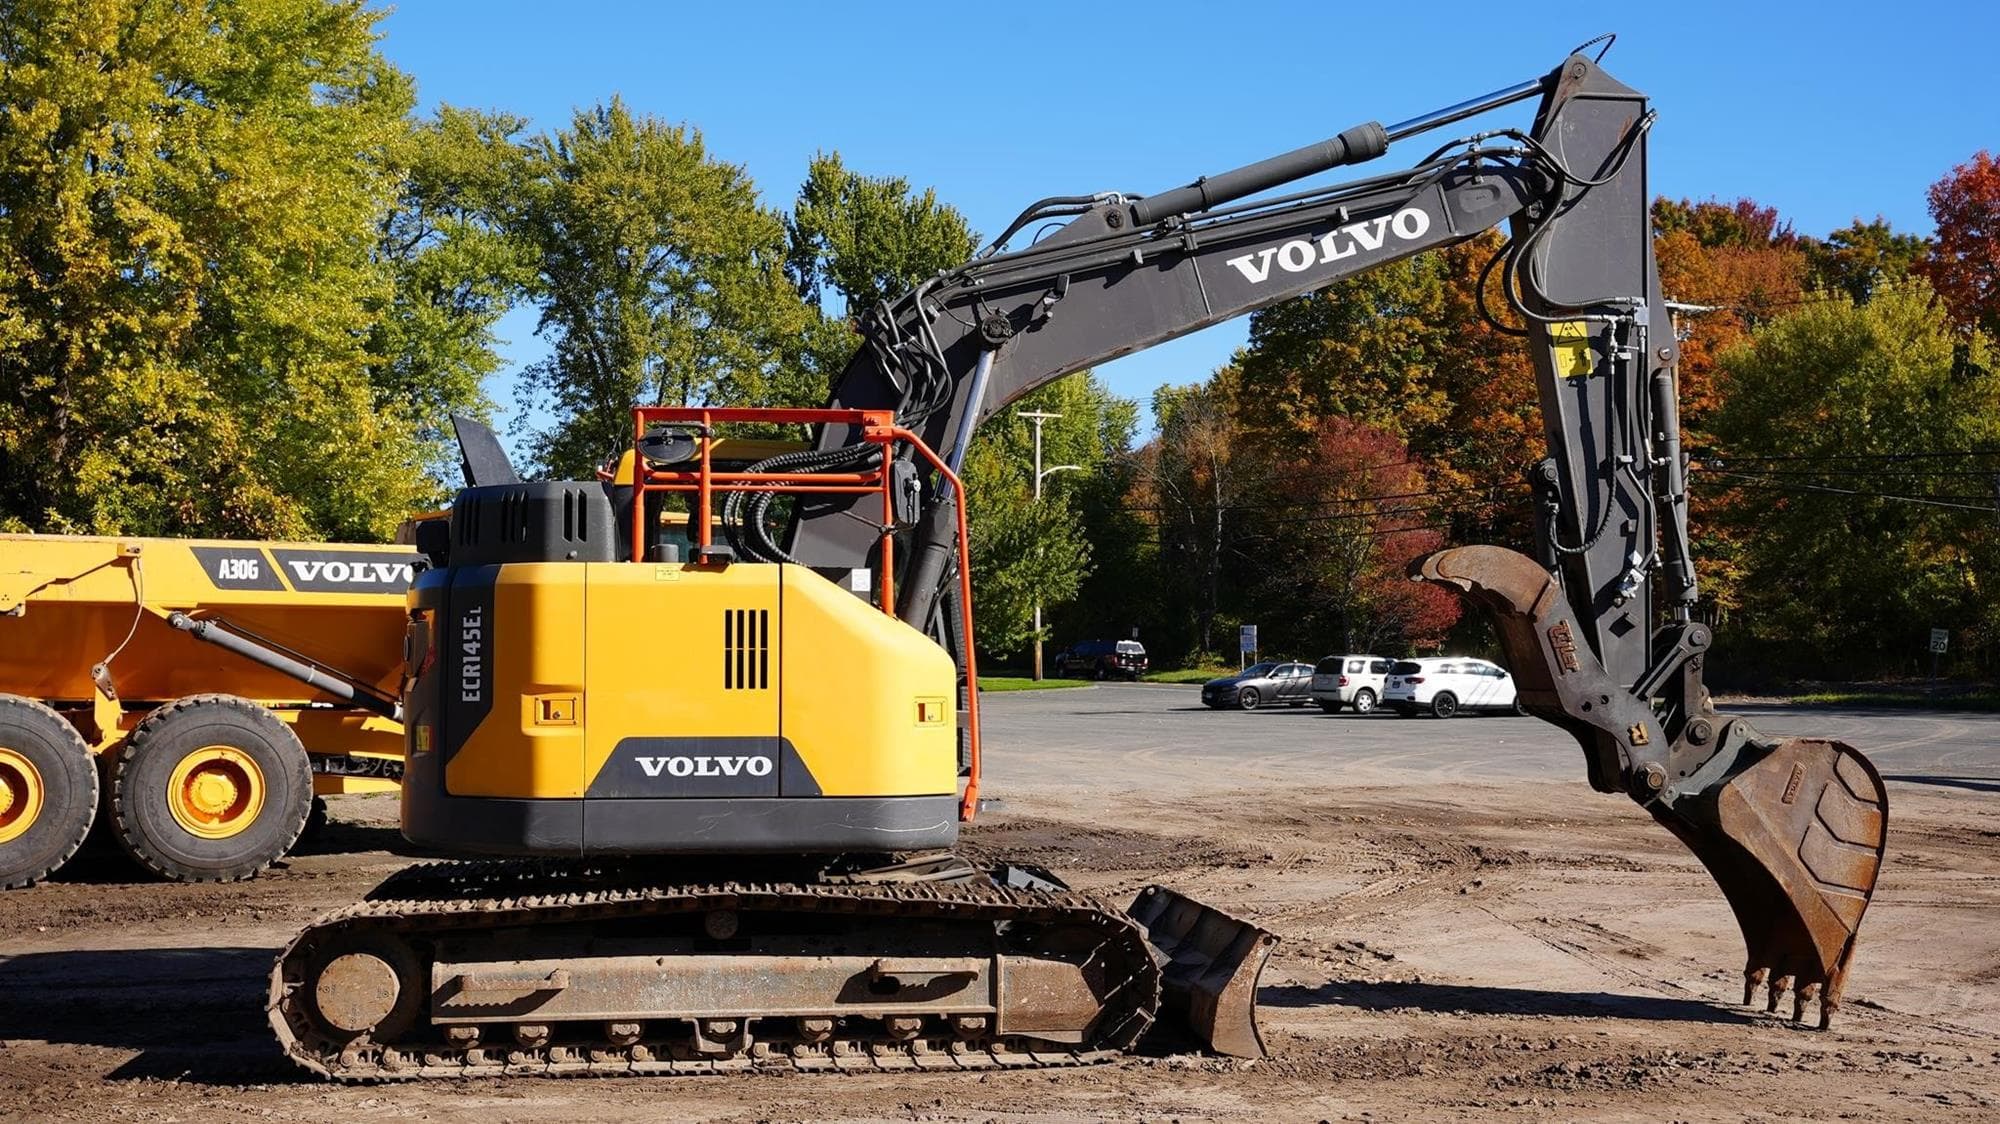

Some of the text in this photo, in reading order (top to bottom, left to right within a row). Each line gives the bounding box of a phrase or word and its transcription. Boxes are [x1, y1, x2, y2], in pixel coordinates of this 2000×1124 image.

[1226, 207, 1430, 284] VOLVO
[219, 559, 259, 580] A30G
[1932, 641, 1946, 651] 20
[635, 756, 773, 777] VOLVO
